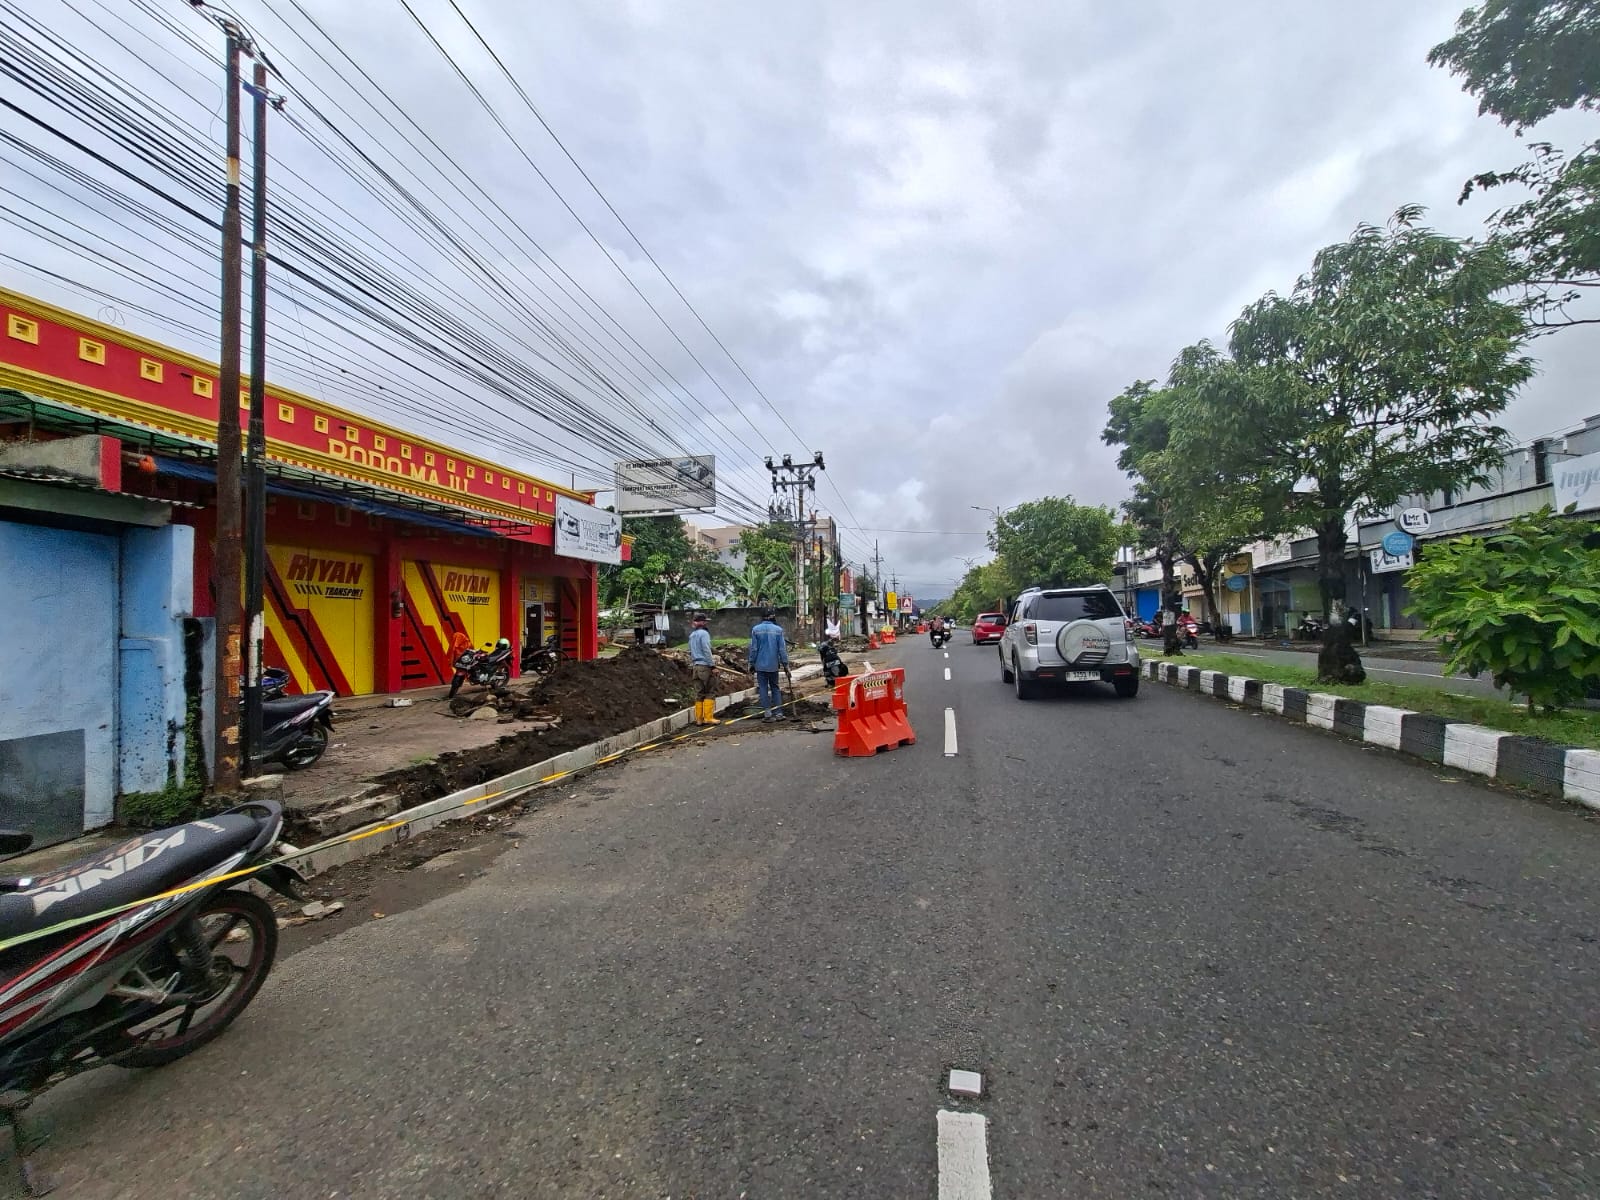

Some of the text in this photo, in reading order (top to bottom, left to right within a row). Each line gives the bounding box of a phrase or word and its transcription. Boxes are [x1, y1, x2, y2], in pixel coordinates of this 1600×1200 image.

[286, 554, 363, 585] RIYAN
[443, 571, 490, 594] RIYAN
[324, 586, 364, 598] TRANSPORT
[466, 594, 490, 604] TRANSPORT
